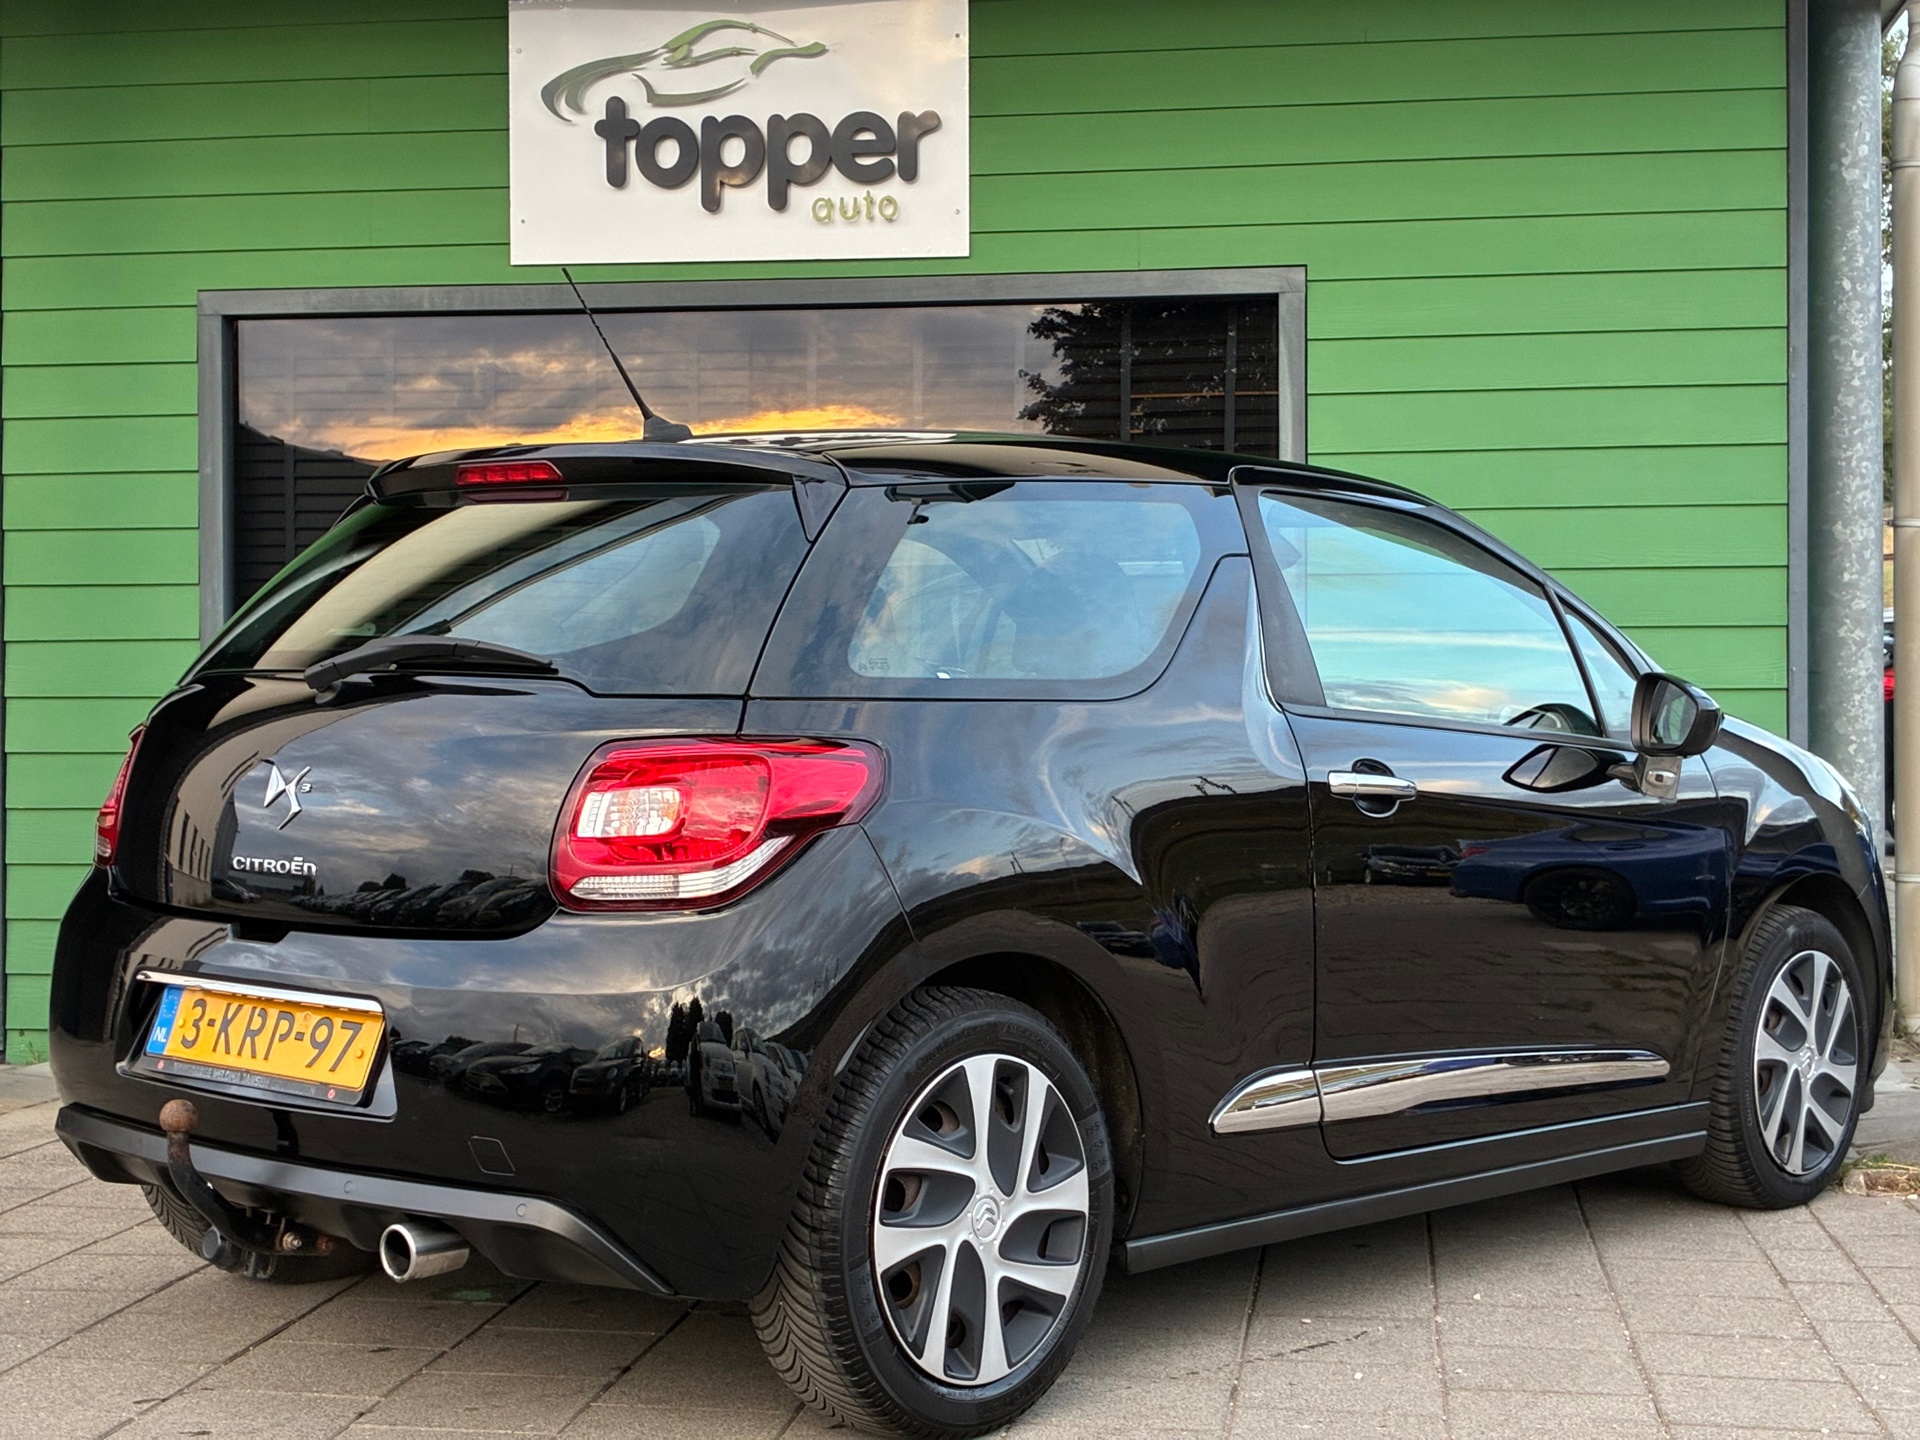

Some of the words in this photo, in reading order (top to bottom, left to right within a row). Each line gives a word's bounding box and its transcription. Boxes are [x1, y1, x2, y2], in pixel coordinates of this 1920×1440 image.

[594, 96, 941, 213] topper
[811, 190, 899, 223] auto
[153, 1026, 168, 1043] NL
[180, 998, 364, 1073] 3-KRP-97
[1085, 1121, 1100, 1136] 195
[1091, 1156, 1107, 1172] R16
